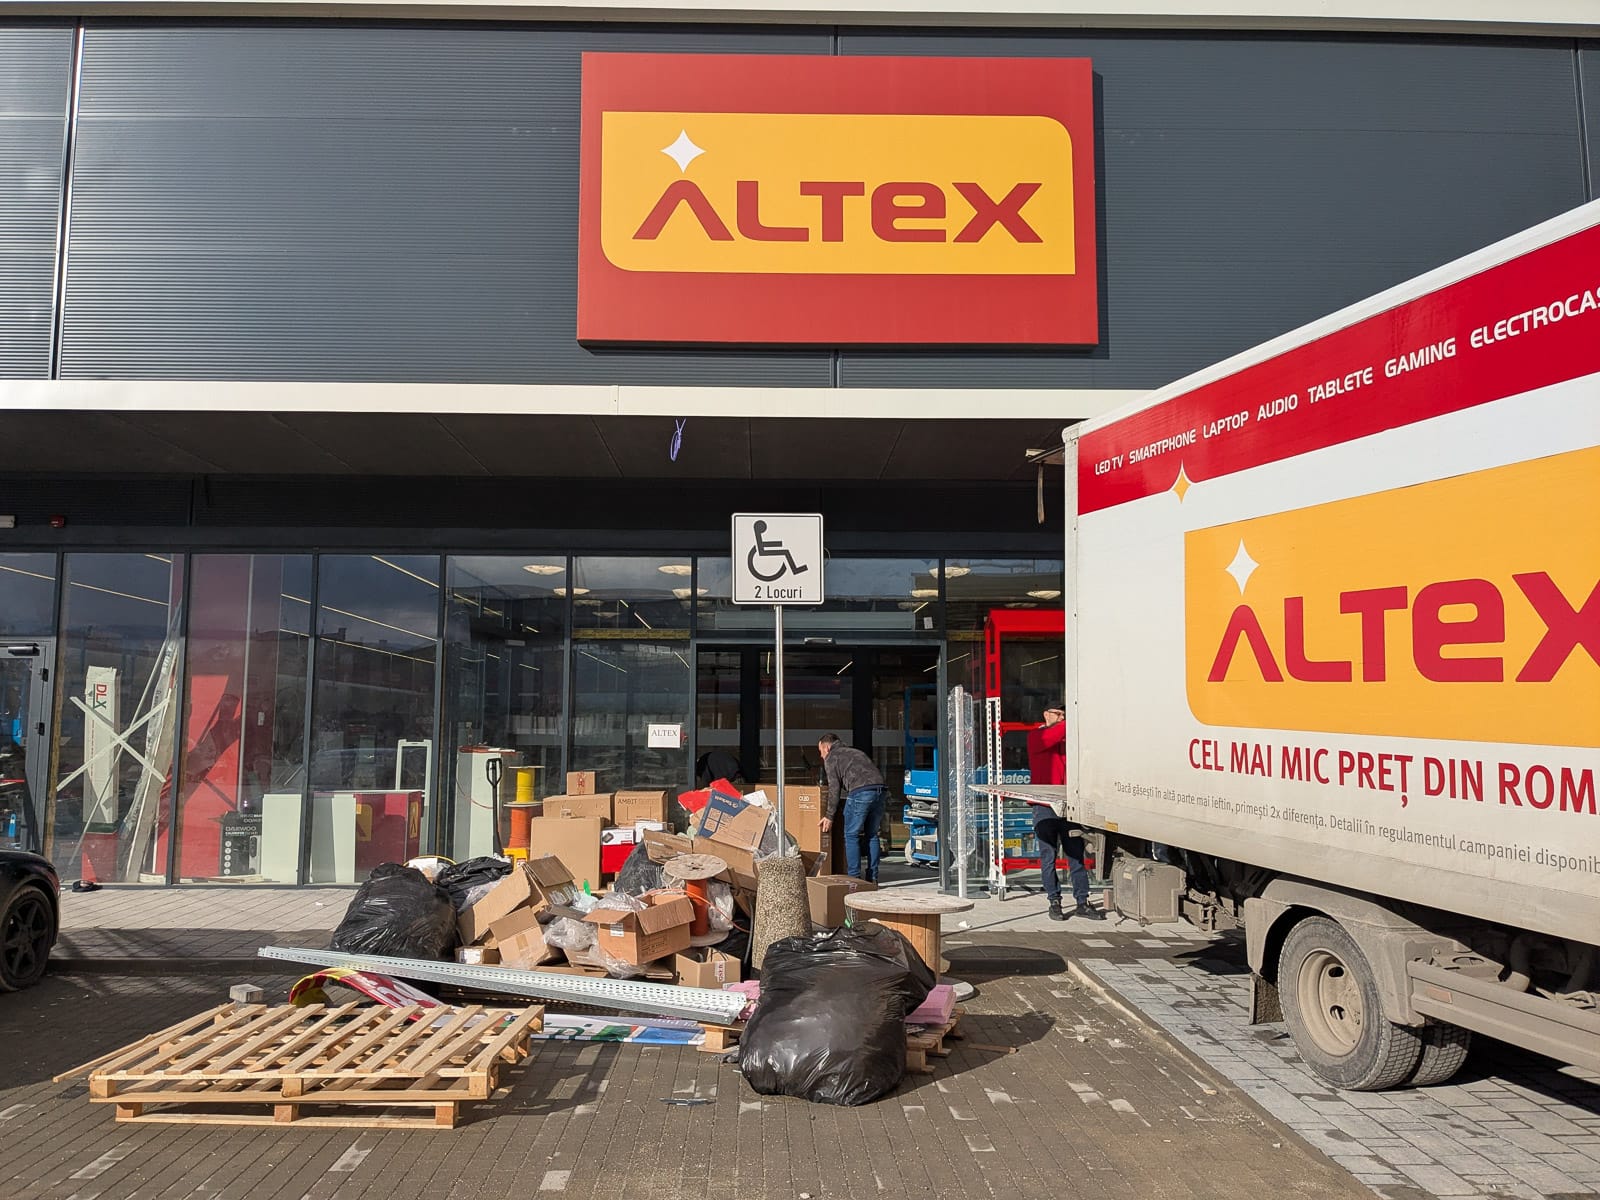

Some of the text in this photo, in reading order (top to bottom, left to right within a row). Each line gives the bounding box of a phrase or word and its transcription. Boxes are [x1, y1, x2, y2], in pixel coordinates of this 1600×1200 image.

[1094, 286, 1600, 475] LED TV SMARTPHONE LAPTOP AUDIO TABLETE GAMING ELECTROCA
[754, 585, 802, 599] 2 Locuri
[95, 683, 108, 710] DLX
[651, 728, 678, 737] ALTEX
[1188, 738, 1600, 815] CEL MAI MIC PREȚ DIN ROM
[1177, 793, 1195, 805] parte
[1197, 795, 1210, 807] mai
[1270, 806, 1281, 820] 2x
[1330, 815, 1363, 834] Detalii
[1365, 820, 1376, 836] în
[1379, 826, 1457, 850] regulamentul
[1460, 837, 1531, 863] campaniei
